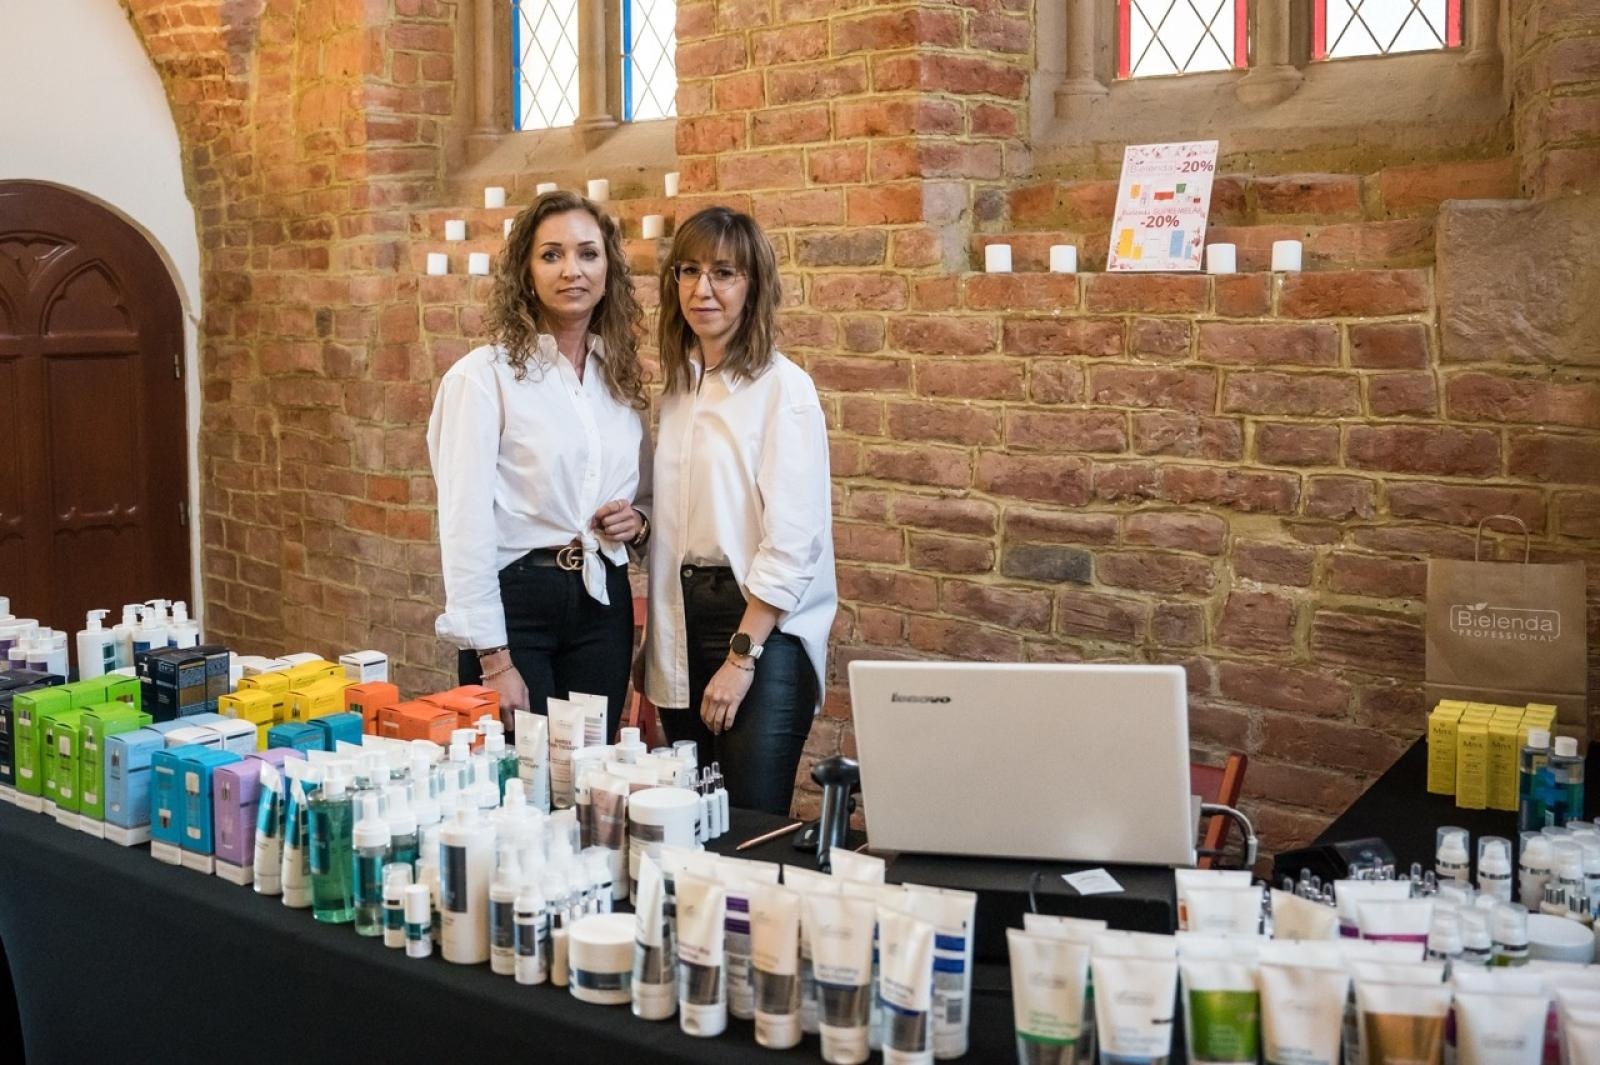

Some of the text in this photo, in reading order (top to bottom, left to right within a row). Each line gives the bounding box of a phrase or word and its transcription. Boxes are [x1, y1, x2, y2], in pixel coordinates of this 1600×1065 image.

[1176, 160, 1214, 173] -20%
[1140, 214, 1180, 228] -20%
[1457, 610, 1553, 631] Bielenda
[1458, 629, 1553, 642] PROFESSIONAL
